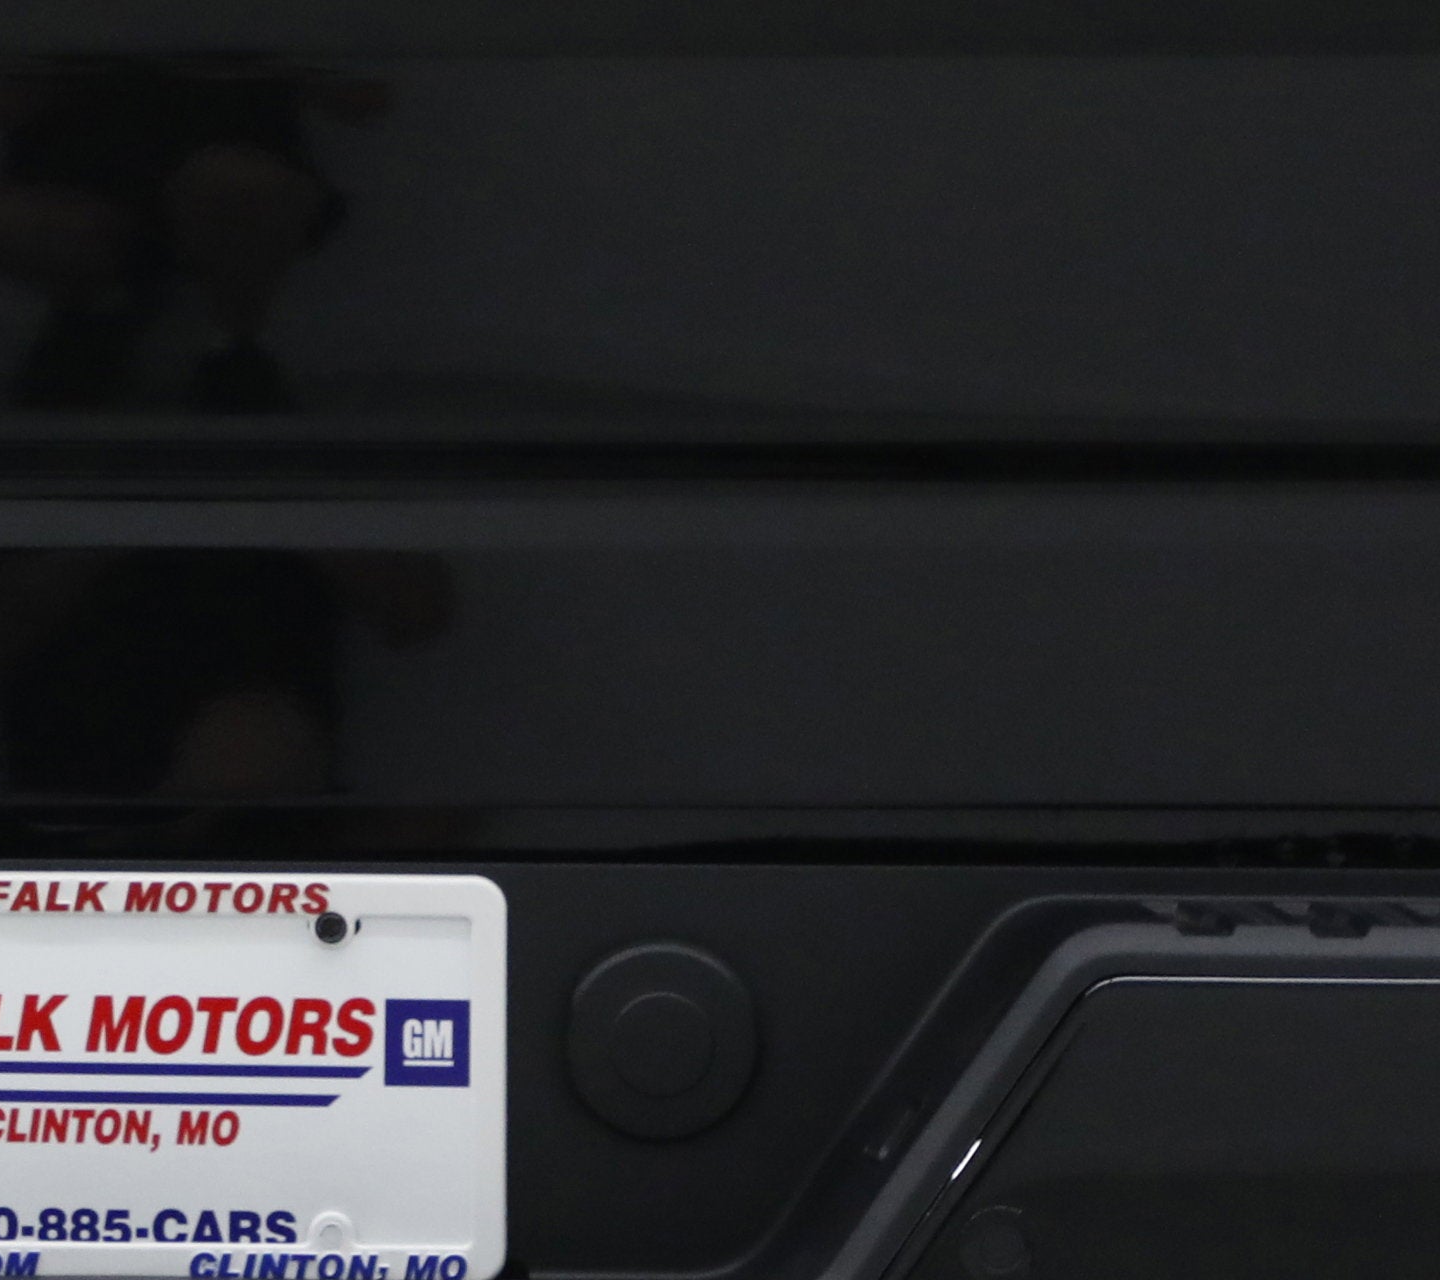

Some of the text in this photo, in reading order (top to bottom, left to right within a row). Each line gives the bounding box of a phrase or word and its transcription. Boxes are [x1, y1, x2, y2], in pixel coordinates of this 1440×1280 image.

[124, 881, 329, 915] MOTORS
[85, 994, 377, 1058] MOTORS
[401, 1018, 454, 1060] GM
[176, 1110, 240, 1147] MO
[189, 1252, 389, 1280] CLINTON,
